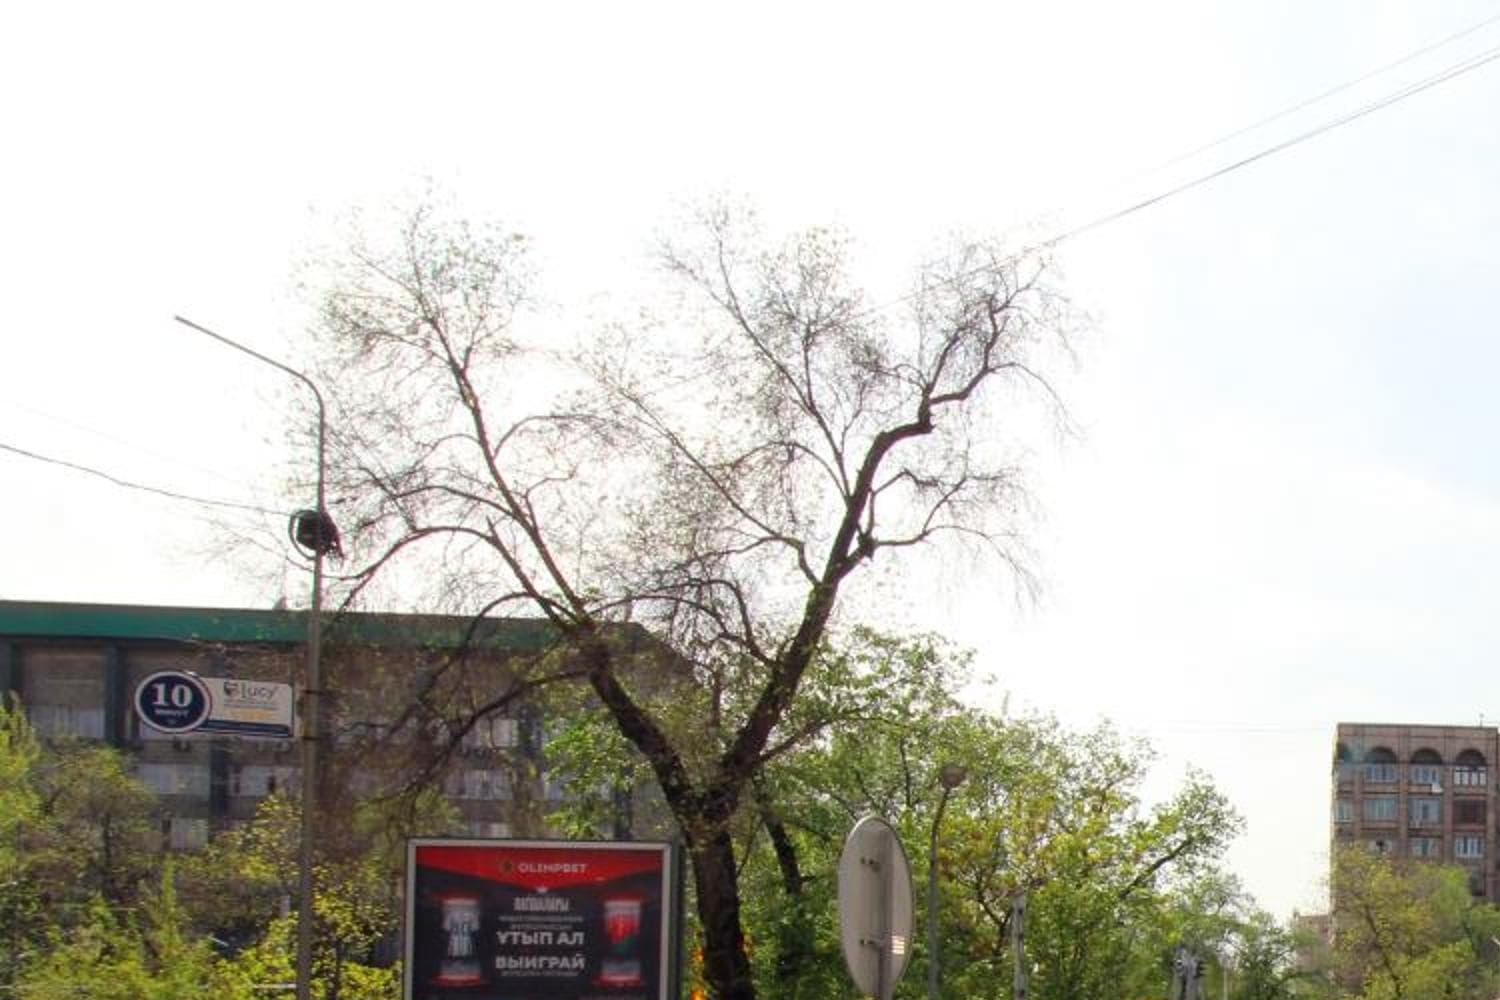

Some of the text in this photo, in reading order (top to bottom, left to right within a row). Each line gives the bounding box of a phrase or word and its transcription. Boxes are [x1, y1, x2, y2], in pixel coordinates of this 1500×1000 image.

[152, 682, 193, 707] 10
[556, 931, 585, 945] АЛ
[495, 952, 585, 969] ВЫИГРАЙ
